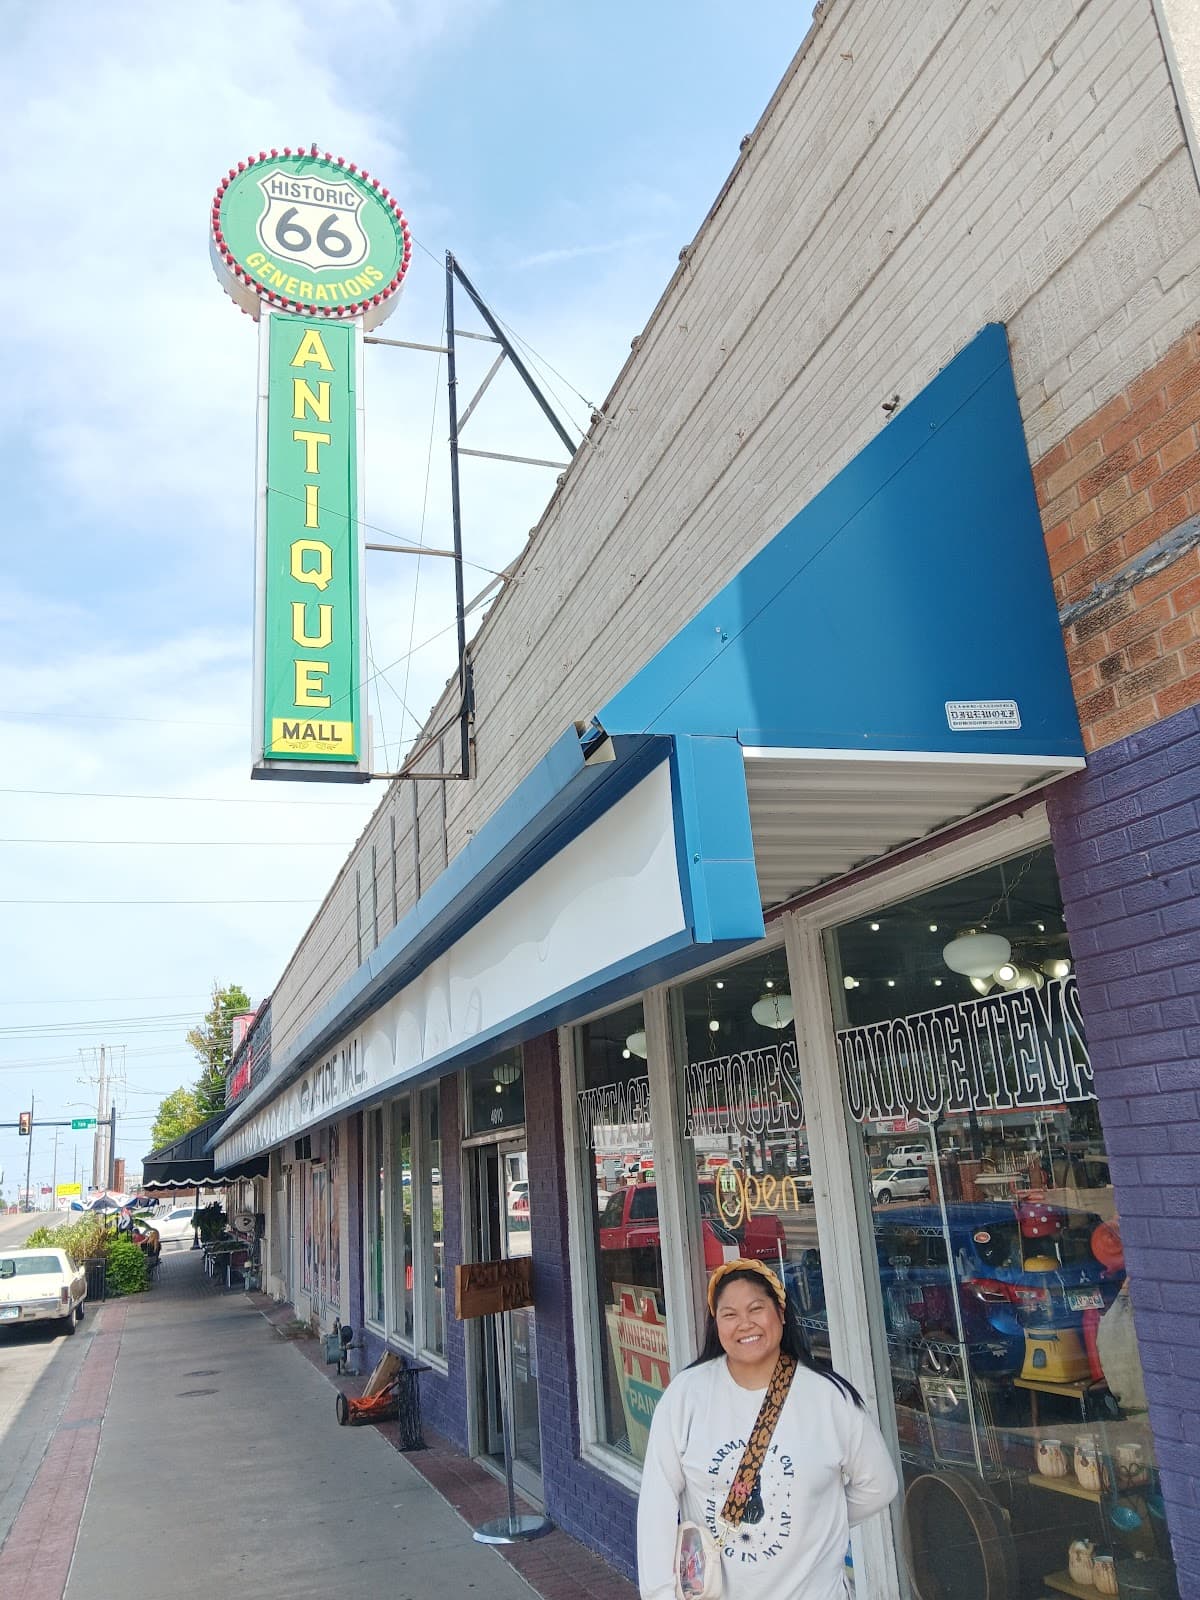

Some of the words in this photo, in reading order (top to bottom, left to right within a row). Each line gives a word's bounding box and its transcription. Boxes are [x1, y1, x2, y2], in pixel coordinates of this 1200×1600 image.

[271, 179, 355, 207] HISTORIC
[275, 206, 353, 259] 66
[246, 252, 384, 301] GENERATIONS
[289, 328, 336, 709] ANTIQUE
[282, 722, 343, 742] MALL
[577, 1075, 654, 1150] VINTAGE
[683, 1041, 805, 1142] ANTIQUES
[617, 1320, 668, 1357] MINNESOTA
[708, 1439, 747, 1475] KARMA
[769, 1444, 779, 1454] A
[780, 1455, 795, 1479] CAT
[741, 1552, 758, 1563] IN
[762, 1541, 783, 1560] MY
[779, 1511, 792, 1537] LAP
